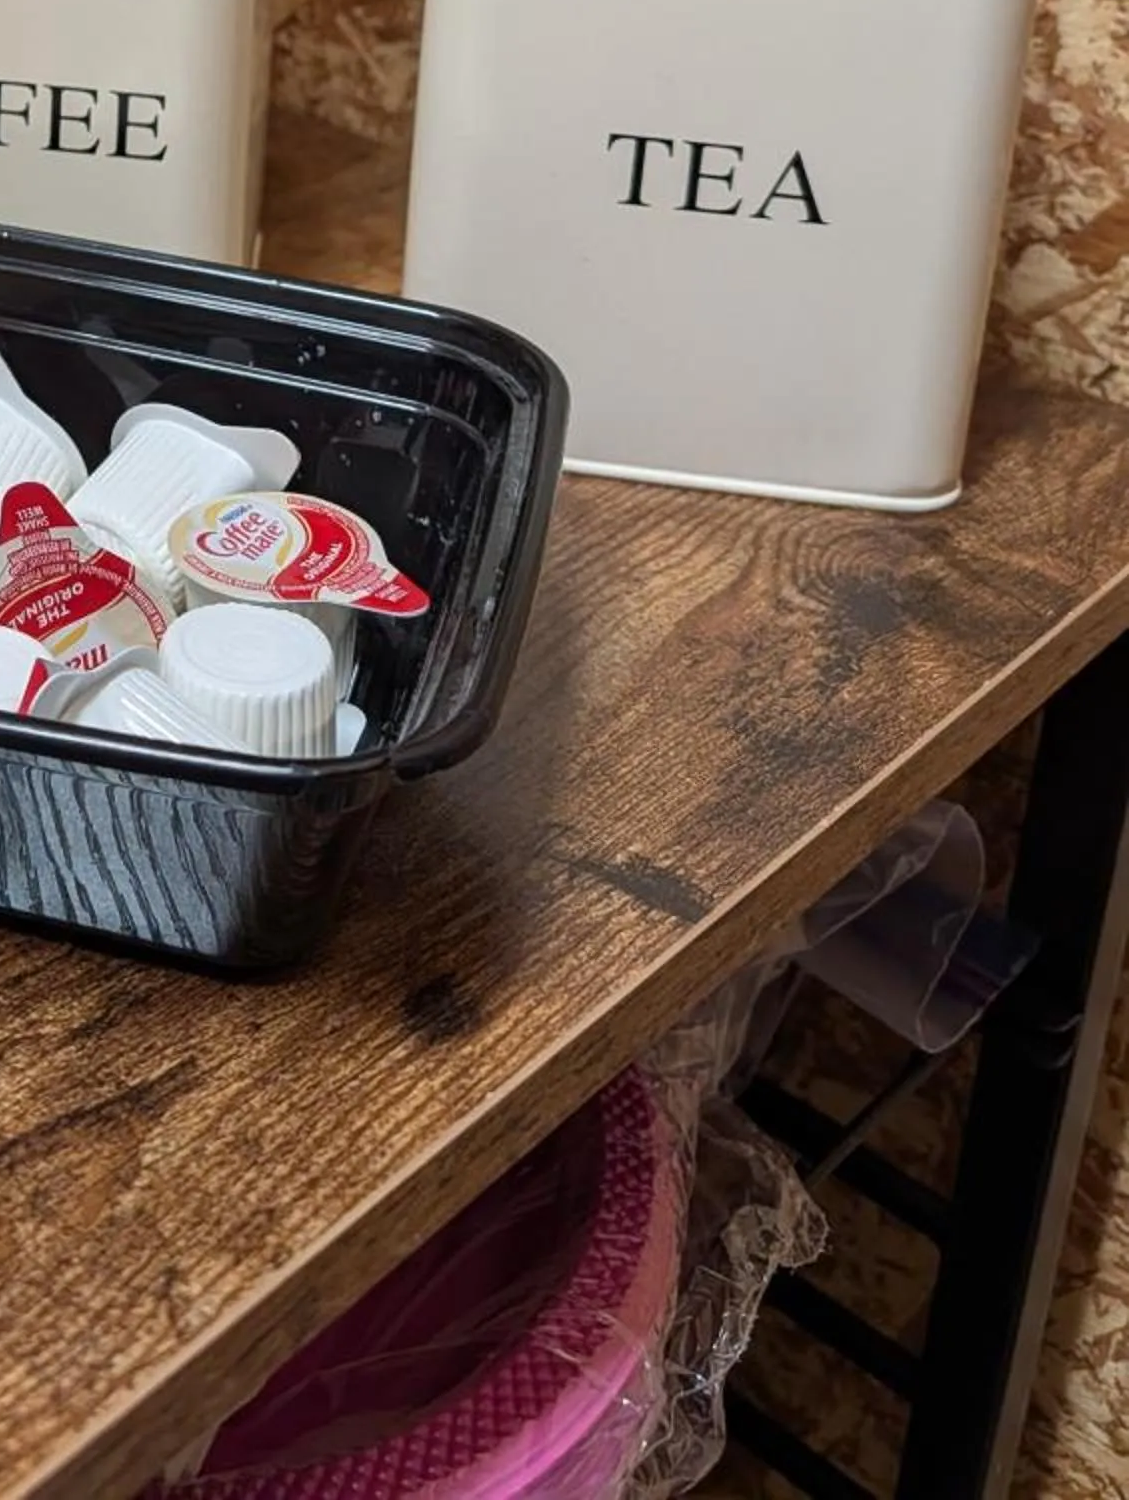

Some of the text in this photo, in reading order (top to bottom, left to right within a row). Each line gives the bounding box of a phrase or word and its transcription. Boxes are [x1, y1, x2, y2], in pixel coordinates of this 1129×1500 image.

[607, 132, 829, 226] TEA
[196, 511, 265, 557] Coffee
[240, 525, 283, 561] mate
[38, 606, 71, 628] THE
